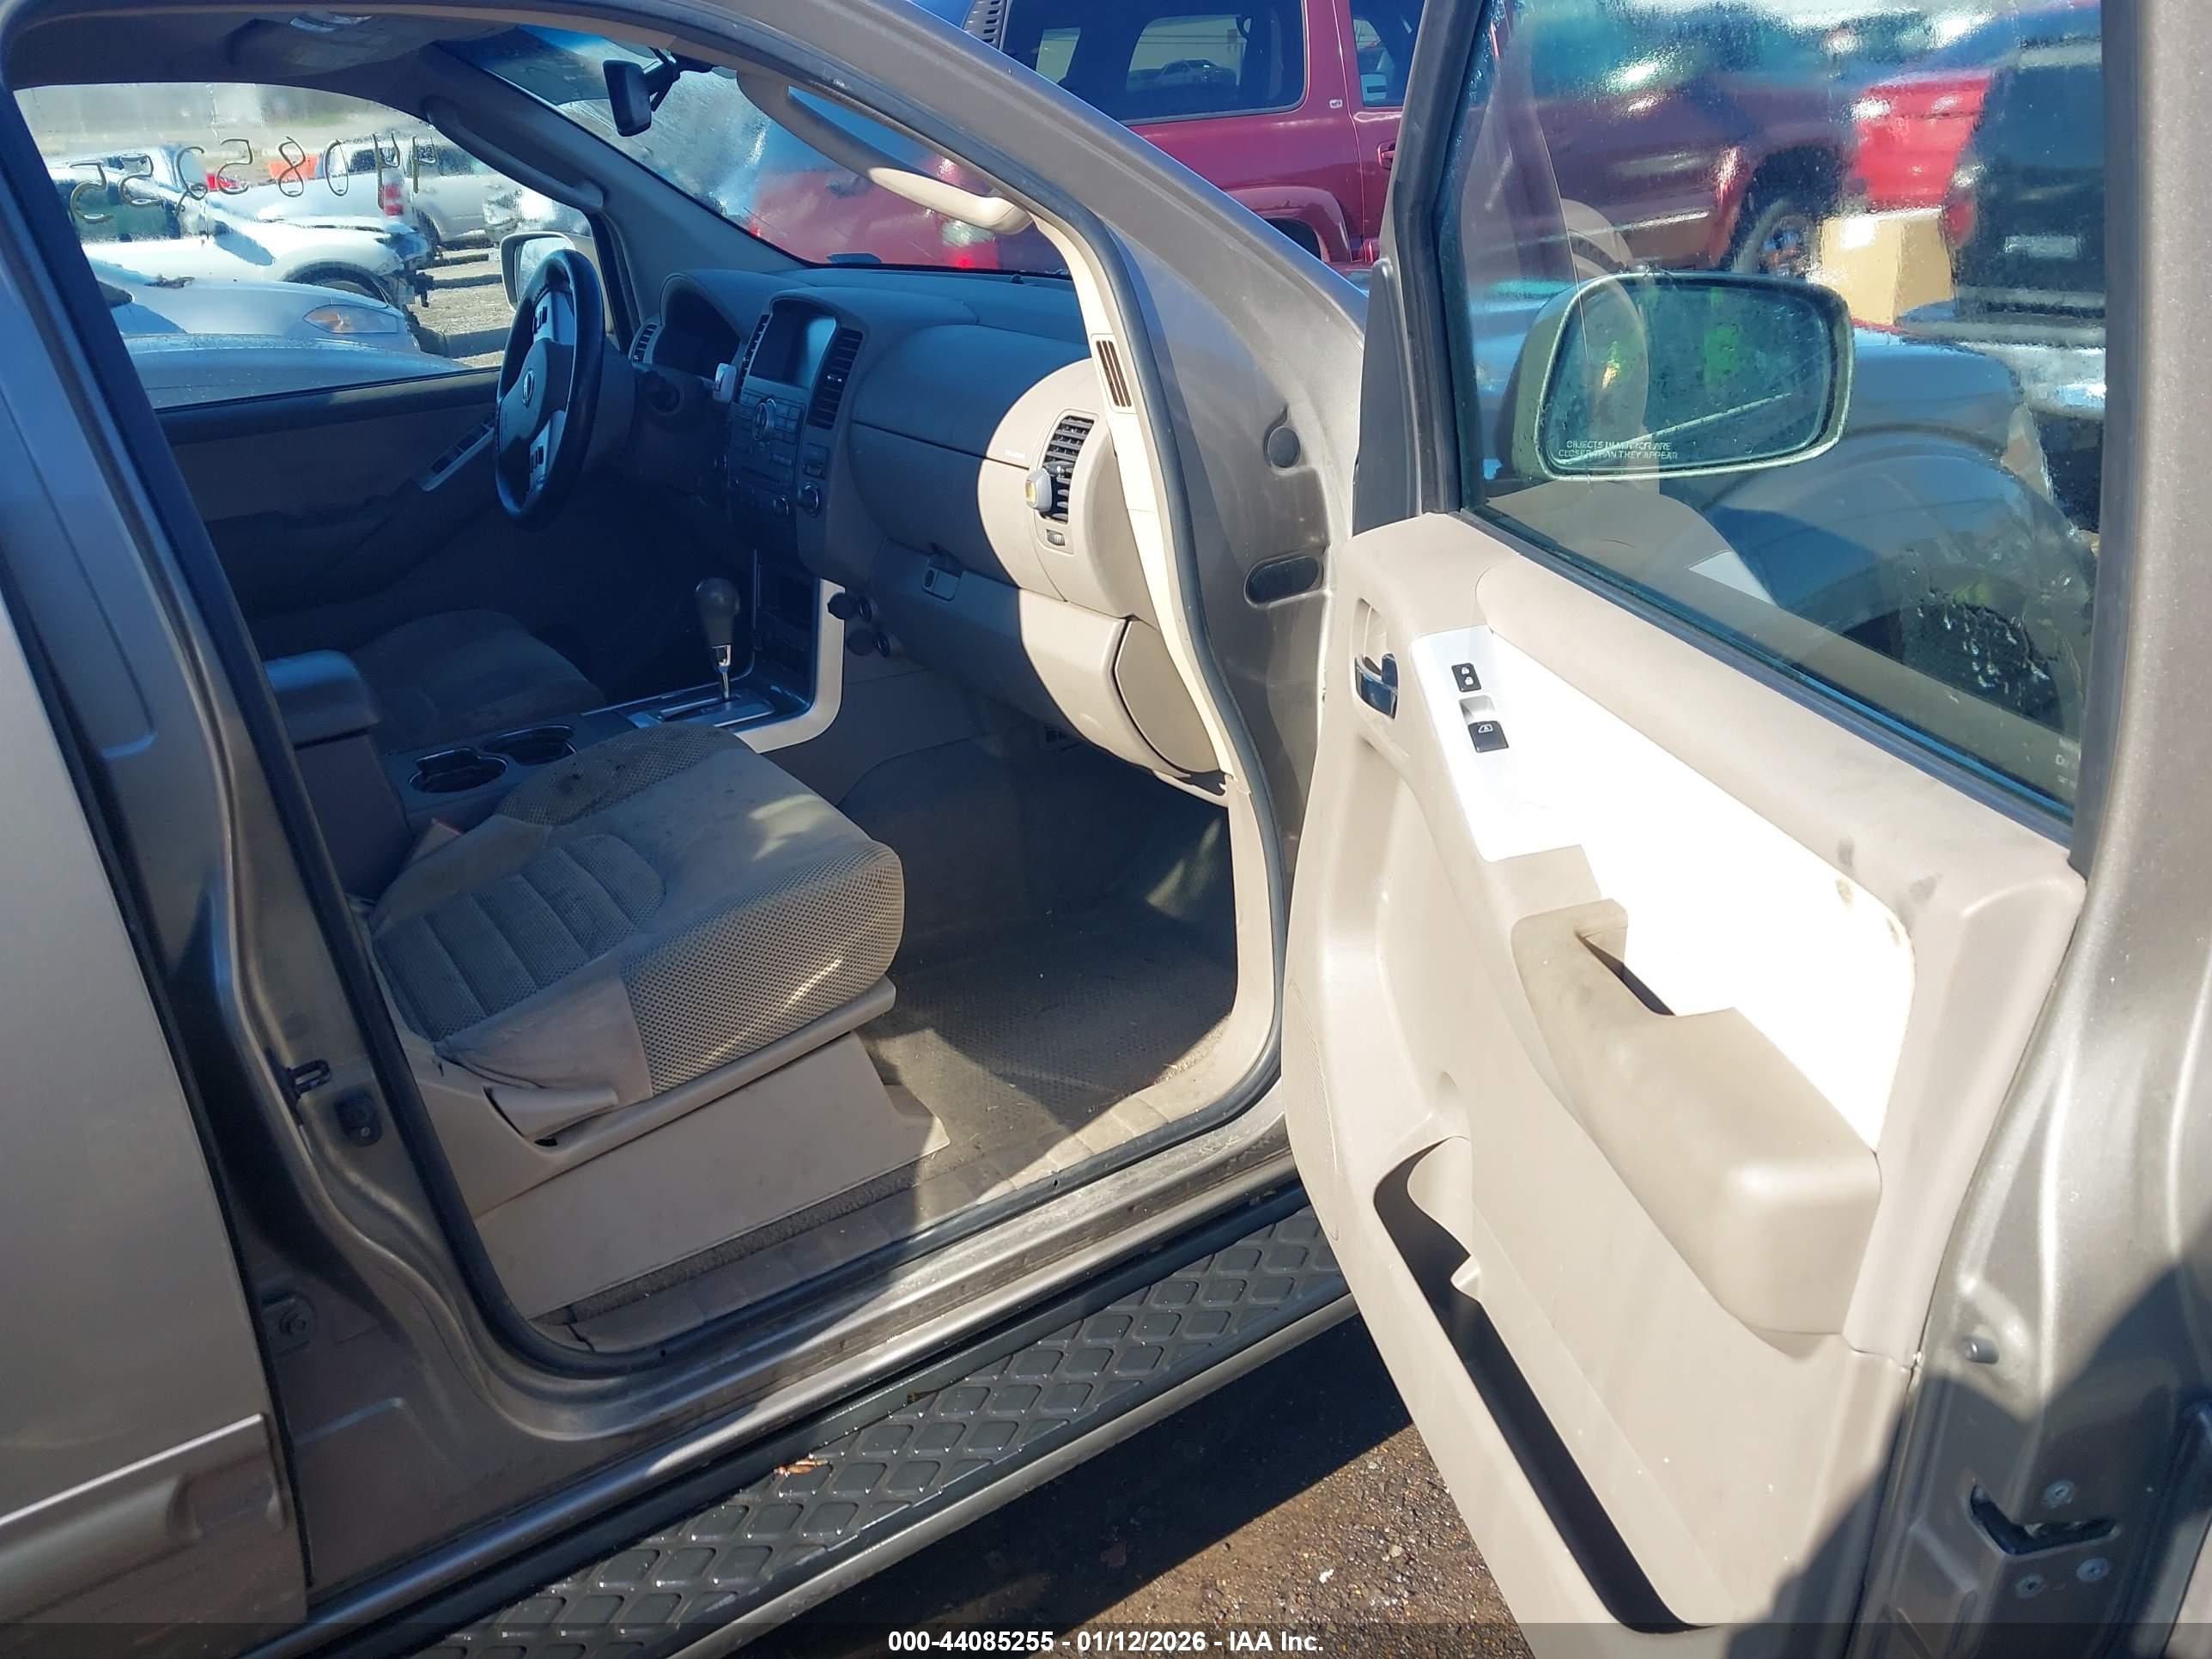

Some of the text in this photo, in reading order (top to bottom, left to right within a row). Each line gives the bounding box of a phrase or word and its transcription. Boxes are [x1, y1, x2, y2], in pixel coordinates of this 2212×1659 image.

[1566, 440, 1603, 449] OBJECTS
[1653, 441, 1672, 451] ARE
[1619, 450, 1642, 459] THEY
[1643, 451, 1678, 460] APPEAR
